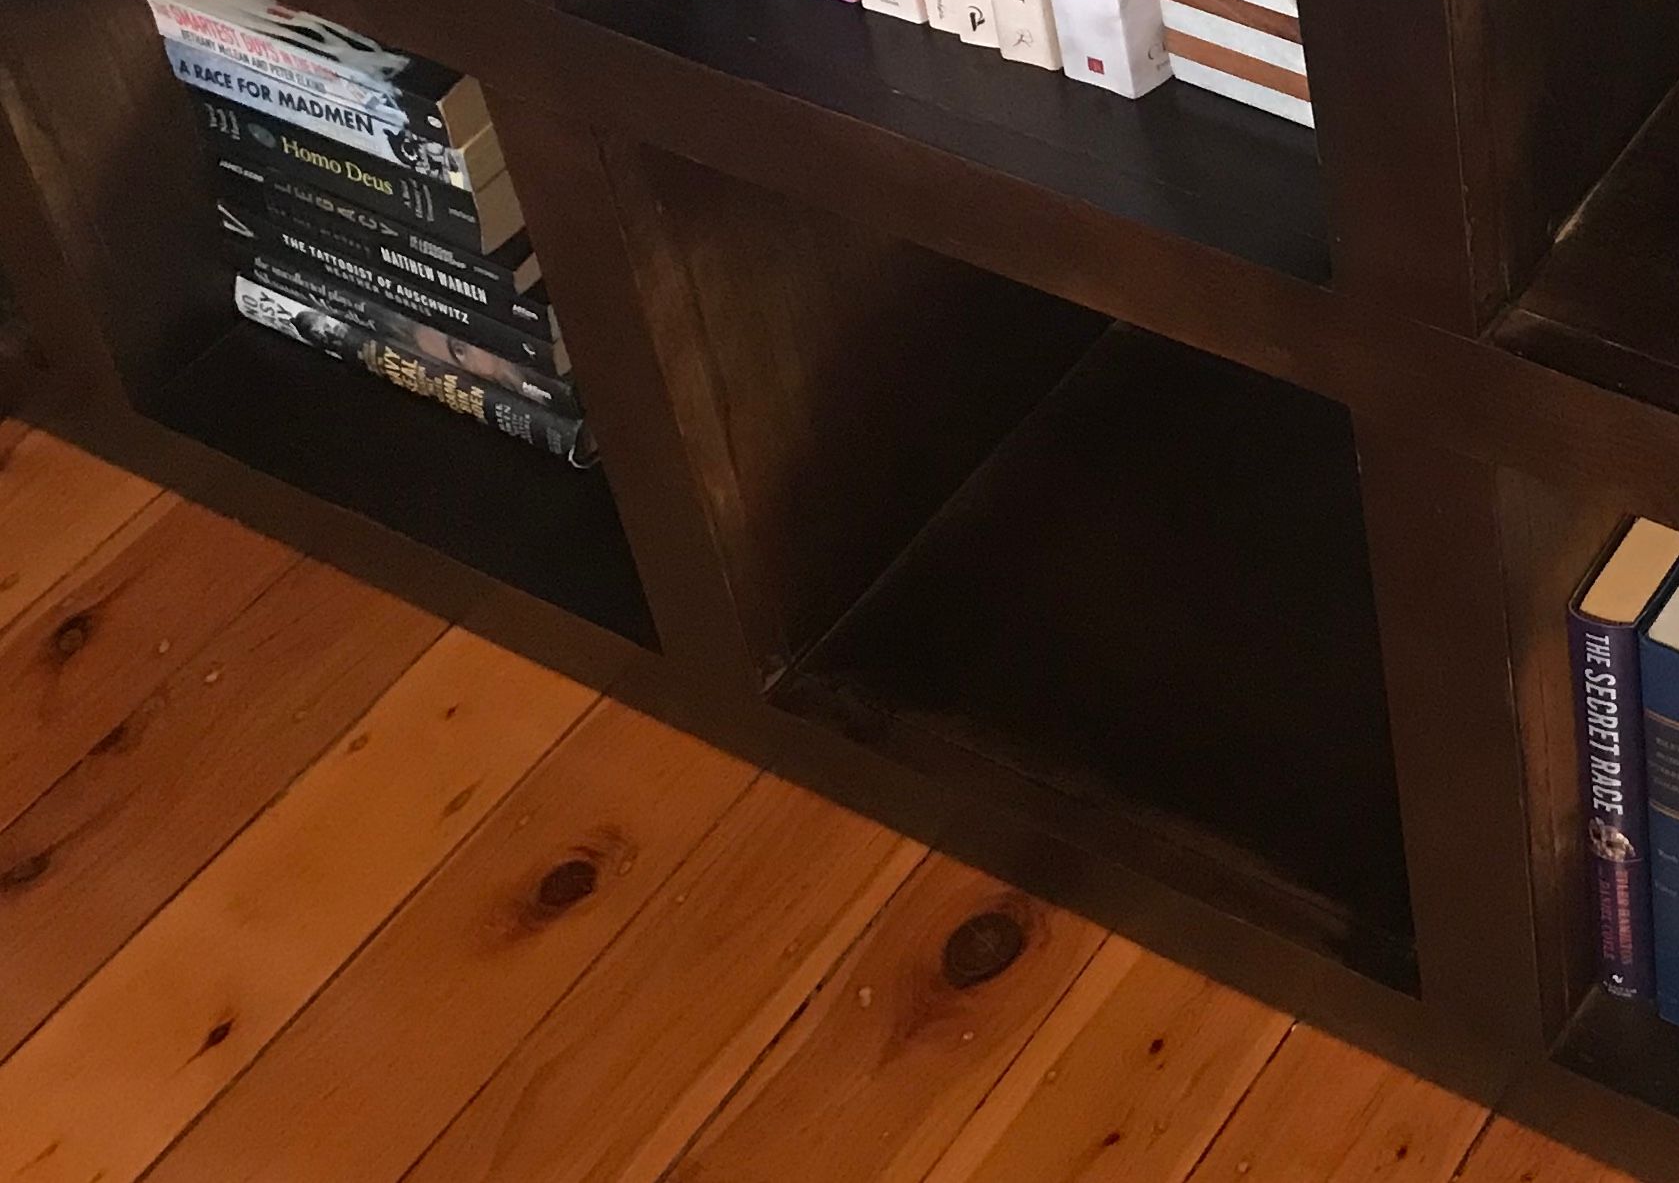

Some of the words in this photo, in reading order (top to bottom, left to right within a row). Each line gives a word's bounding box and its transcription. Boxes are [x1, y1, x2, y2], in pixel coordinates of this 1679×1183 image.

[179, 59, 191, 76] A
[193, 63, 232, 90] RACE
[236, 76, 273, 103] FOR
[278, 91, 376, 136] MADMEN
[281, 135, 342, 175] Homo
[344, 161, 394, 196] Deus
[274, 182, 399, 237] LEGACY
[282, 233, 307, 254] THE
[308, 245, 373, 281] TATTOOIST
[377, 275, 393, 290] OF
[396, 284, 470, 325] AUSCHWITZ
[380, 246, 435, 282] MATTHEW
[436, 270, 488, 305] WARREN
[1585, 632, 1611, 668] THE
[1584, 668, 1620, 756] SECRET
[1590, 755, 1624, 816] RACE
